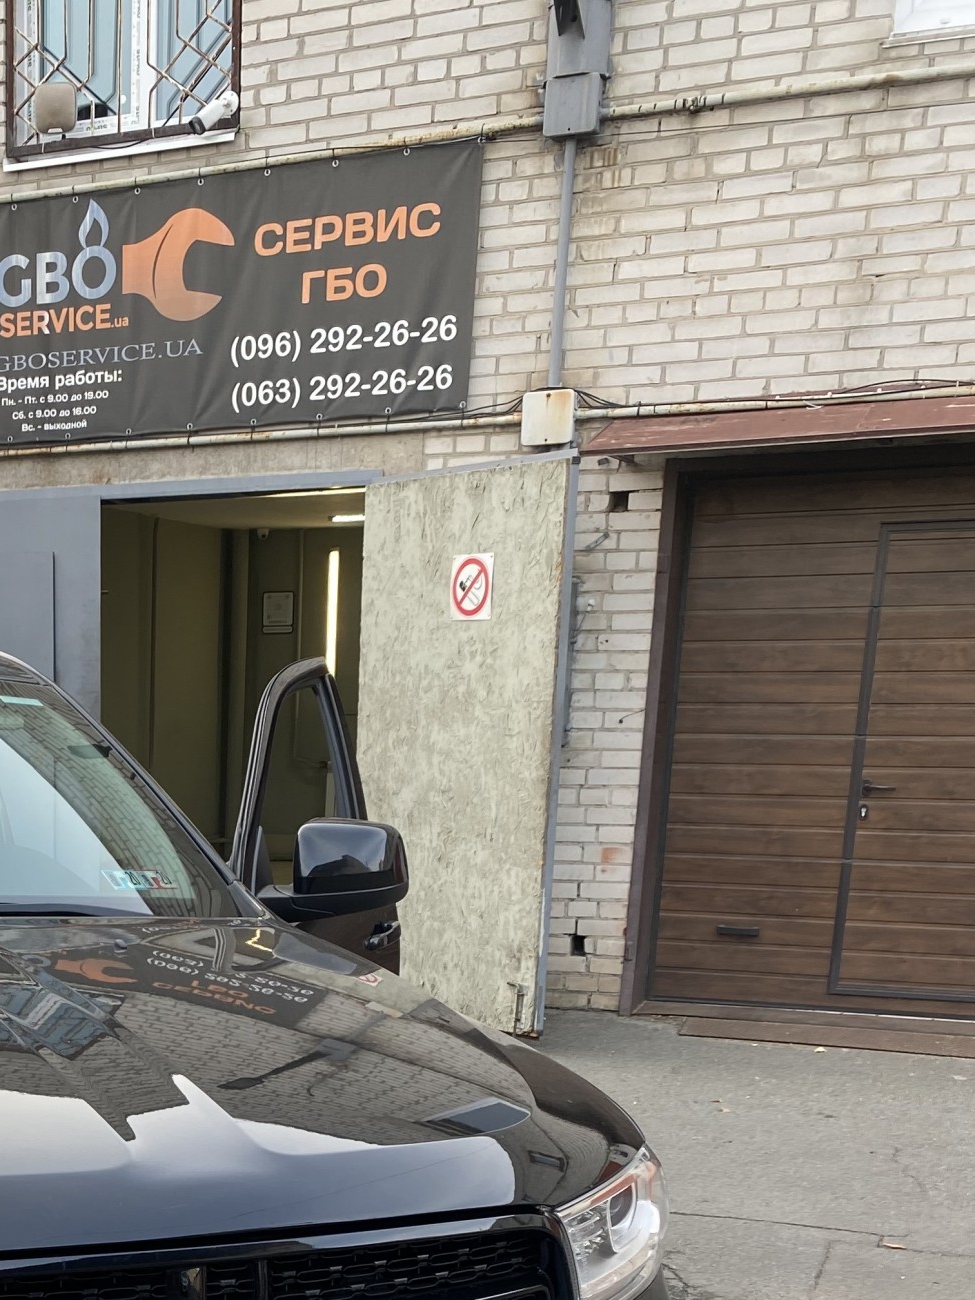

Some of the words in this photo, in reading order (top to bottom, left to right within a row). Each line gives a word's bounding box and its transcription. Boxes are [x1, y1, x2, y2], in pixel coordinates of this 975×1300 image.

[254, 202, 441, 256] СЕРВИС
[302, 264, 388, 304] ГБО
[231, 330, 300, 368] (096)
[310, 315, 457, 354] 292-26-26
[55, 370, 122, 390] работы:
[232, 378, 300, 413] (063)
[310, 364, 452, 401] 292-26-26
[2, 398, 16, 406] Пн.
[24, 396, 38, 404] Пт.
[47, 394, 69, 403] 9.00
[70, 394, 82, 402] до
[12, 410, 26, 420] Сб.
[35, 409, 57, 418] 9.00
[59, 409, 70, 417] до
[44, 419, 87, 430] выходной
